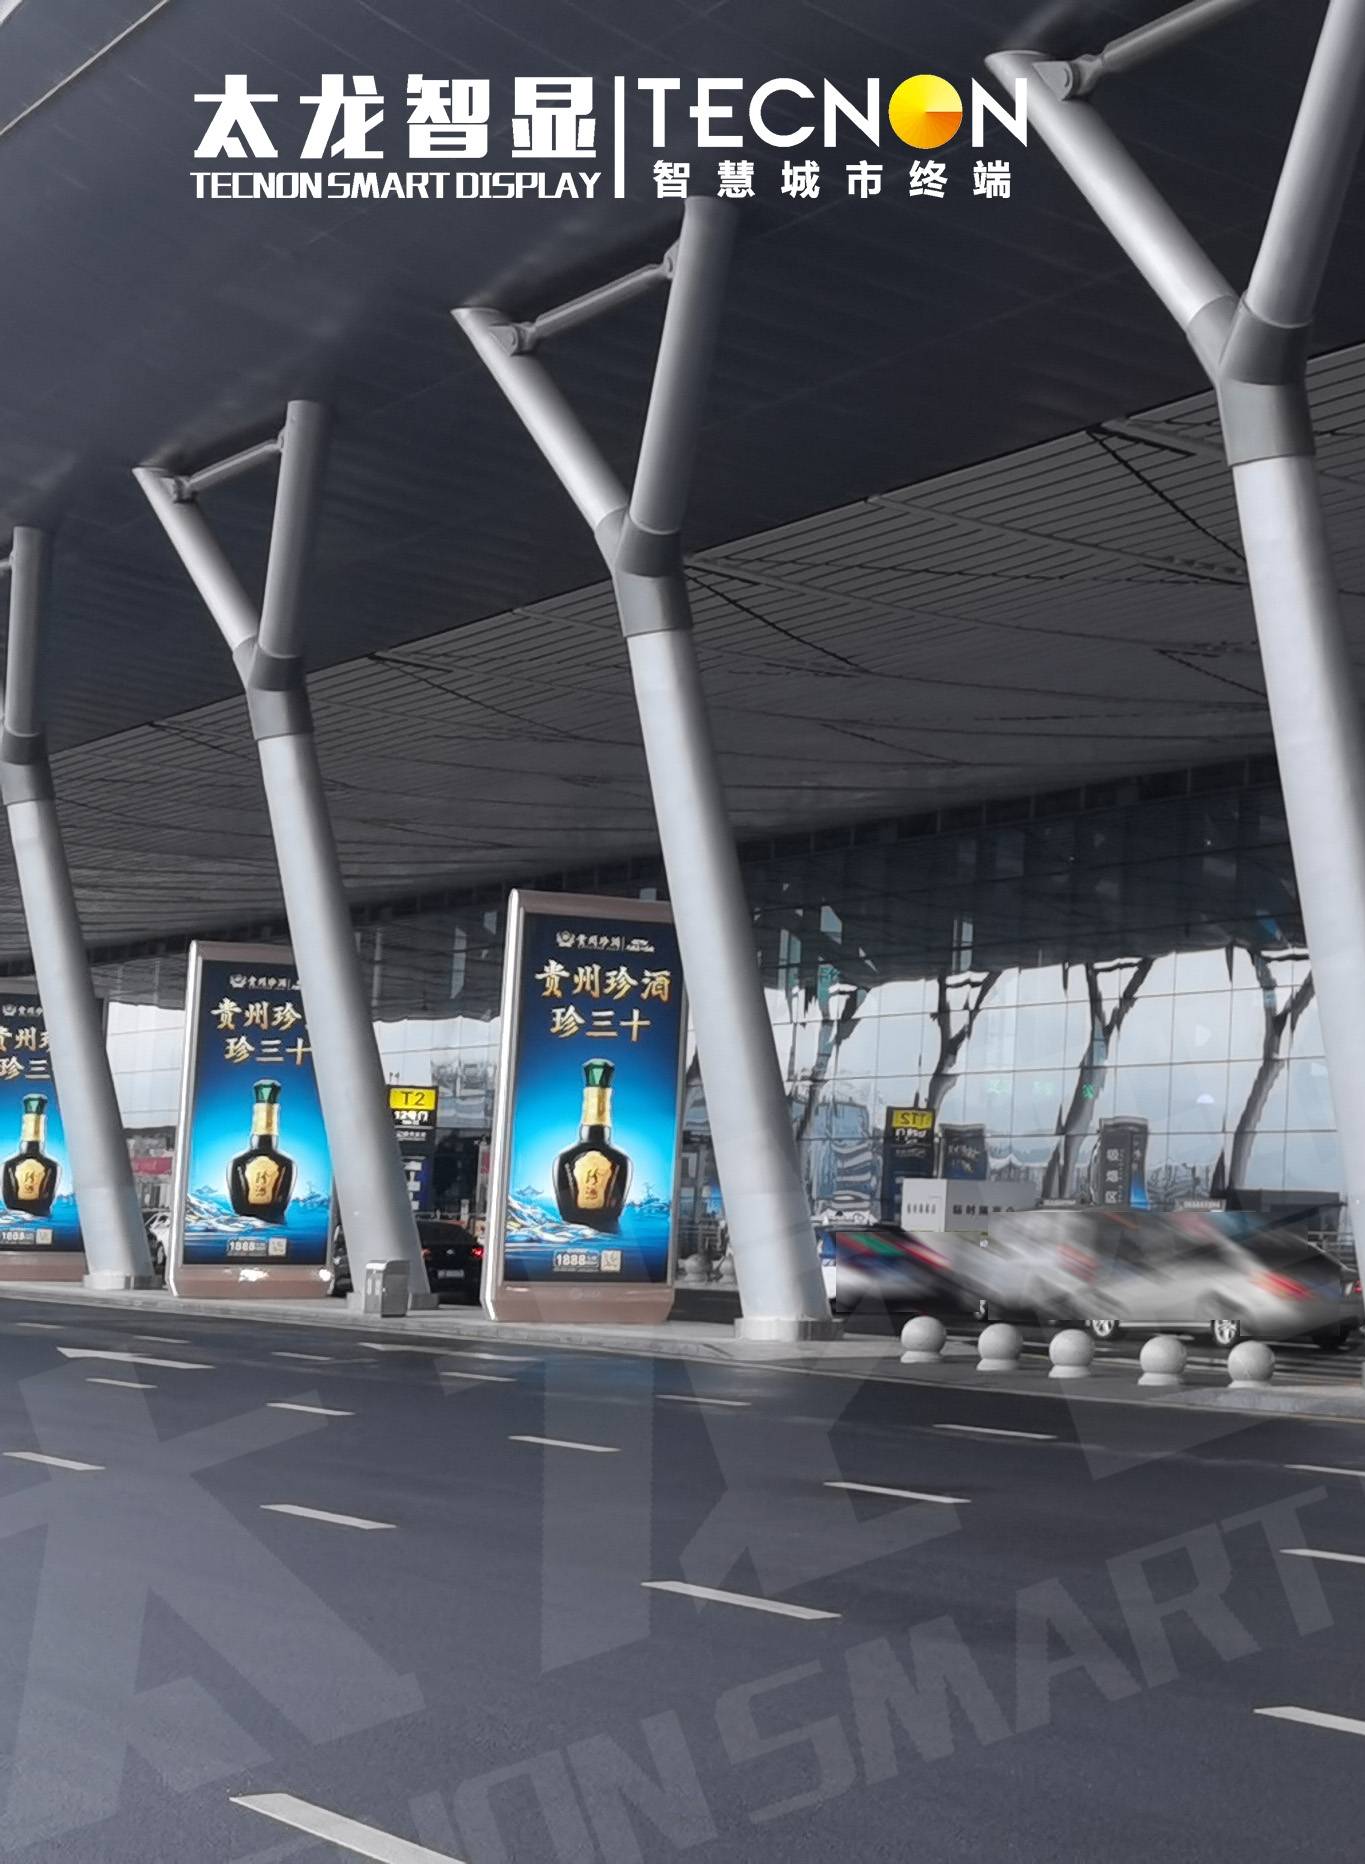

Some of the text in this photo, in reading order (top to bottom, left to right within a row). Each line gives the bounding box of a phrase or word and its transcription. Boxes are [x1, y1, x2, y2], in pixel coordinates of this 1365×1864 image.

[535, 959, 672, 1002] 贵州珍酒
[210, 997, 307, 1031] 贵州珍
[550, 1004, 651, 1043] 珍三十
[224, 1035, 312, 1065] 珍三十
[401, 1091, 425, 1107] T2
